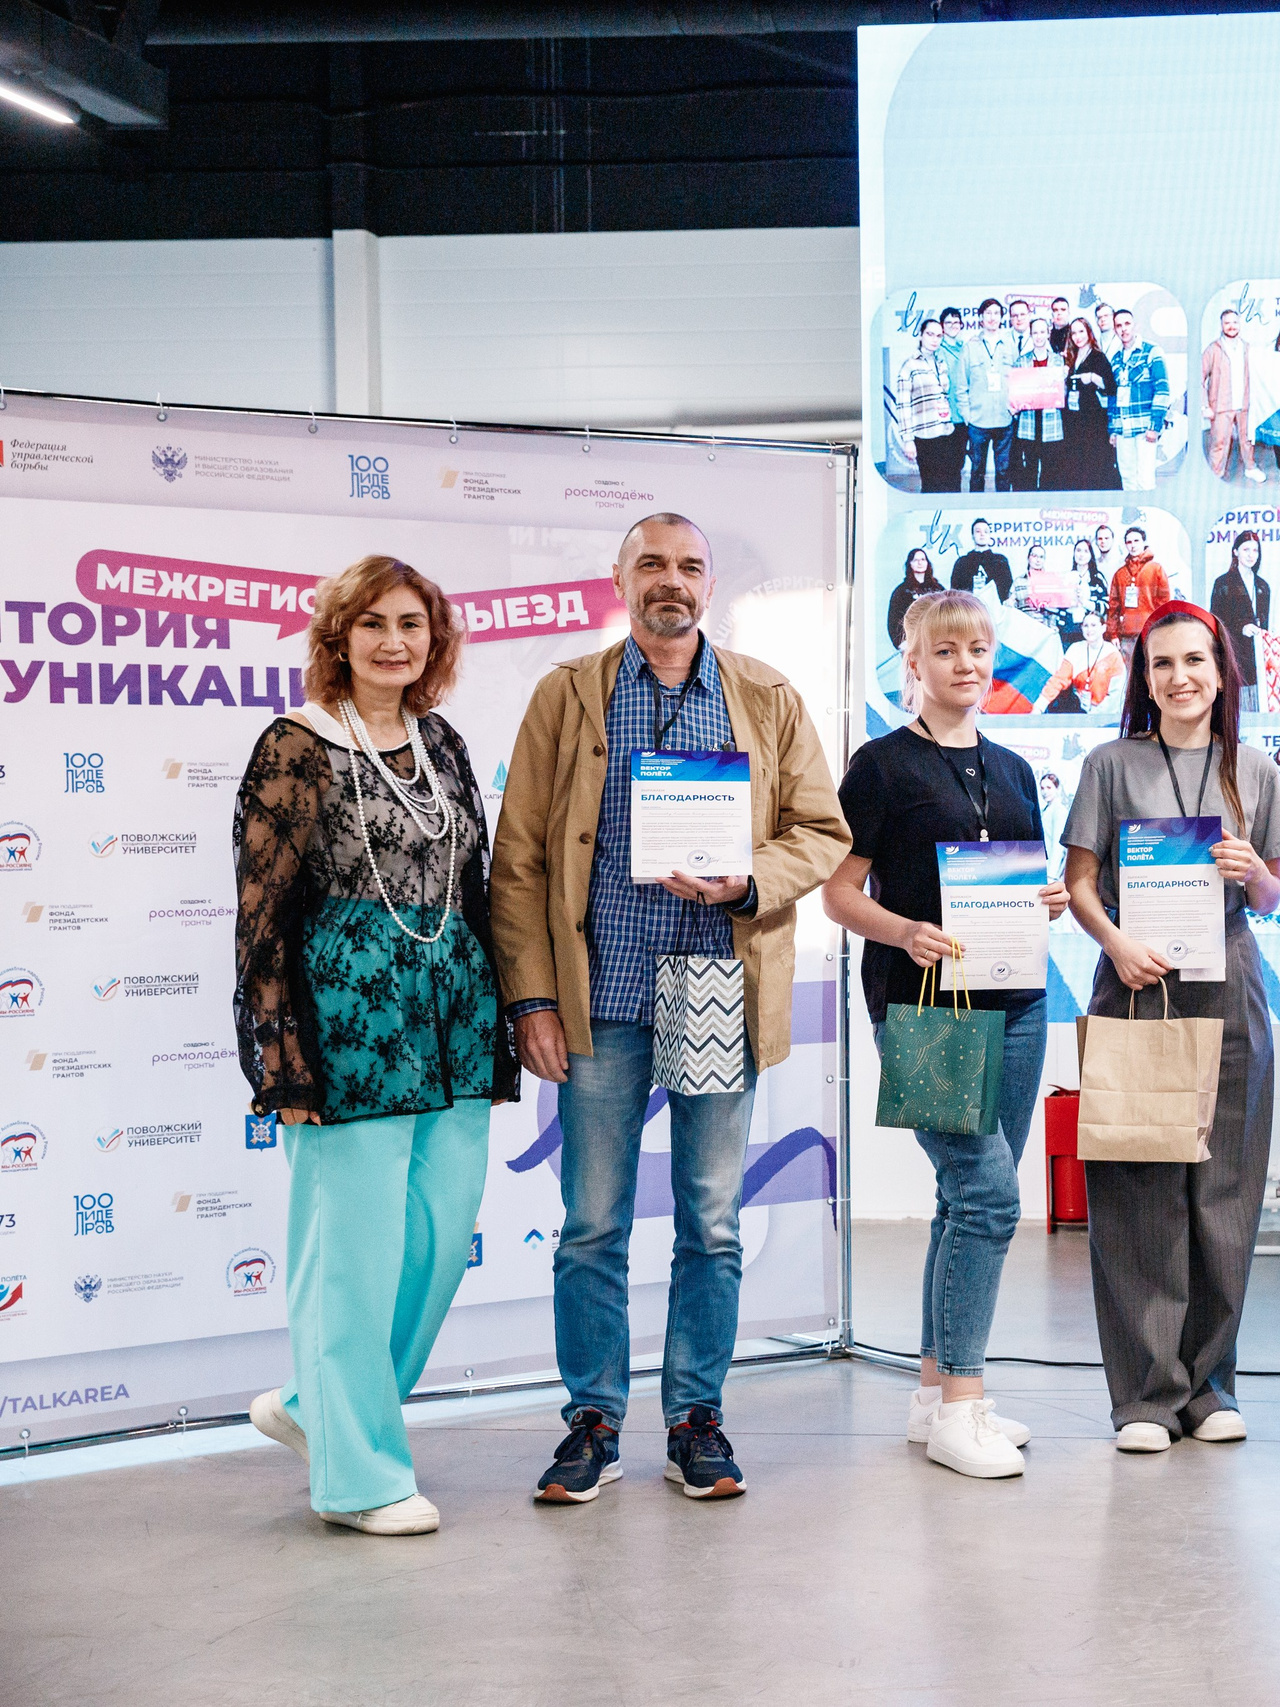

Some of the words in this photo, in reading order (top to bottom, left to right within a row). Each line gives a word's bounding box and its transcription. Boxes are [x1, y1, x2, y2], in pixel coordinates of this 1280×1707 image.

[10, 439, 67, 451] Федерация
[11, 451, 94, 465] управленческой
[194, 455, 252, 465] МИНИСТЕРСТВО
[11, 460, 49, 471] борьбы
[348, 454, 389, 473] 100
[239, 466, 294, 474] ОБРАЗОВАНИЯ
[195, 470, 244, 479] РОССИЙСКОЙ
[246, 473, 291, 482] ФЕДЕРАЦИИ
[464, 486, 521, 494] ПРЕЗИДЕНТСКИХ
[565, 487, 654, 501] росмолодёжь
[464, 493, 495, 501] ГРАНТОВ
[595, 501, 625, 509] гранты
[988, 522, 1075, 532] ЕРРИТОРИЯ
[0, 600, 231, 650] ТОРИЯ
[63, 753, 104, 768] 100
[641, 794, 735, 802] БЛАГОДАРНОСТЬ
[121, 831, 197, 842] ПОВОЛЖСКИЙ
[122, 846, 197, 855] УНИВЕРСИТЕТ
[948, 873, 977, 881] ПОЛЁТА
[1127, 879, 1210, 889] БЛАГОДАРНОСТЬ
[950, 900, 1035, 909] БЛАГОДАРНОСТЬ
[181, 919, 212, 927] гранты
[124, 972, 199, 984] ПОВОЛЖСКИЙ
[124, 987, 199, 997] УНИВЕРСИТЕТ
[52, 1063, 111, 1071] ПРЕЗИДЕНТСКИХ
[184, 1062, 215, 1071] гранты
[126, 1121, 202, 1135] ПОВОЛЖСКИЙ
[127, 1134, 201, 1147] УНИВЕРСИТЕТ
[73, 1192, 113, 1210] 100
[196, 1202, 252, 1212] ПРЕЗИДЕНТСКИХ
[1, 1274, 27, 1282] ПОЛЁТА
[0, 1383, 130, 1418] /TALKAREA
